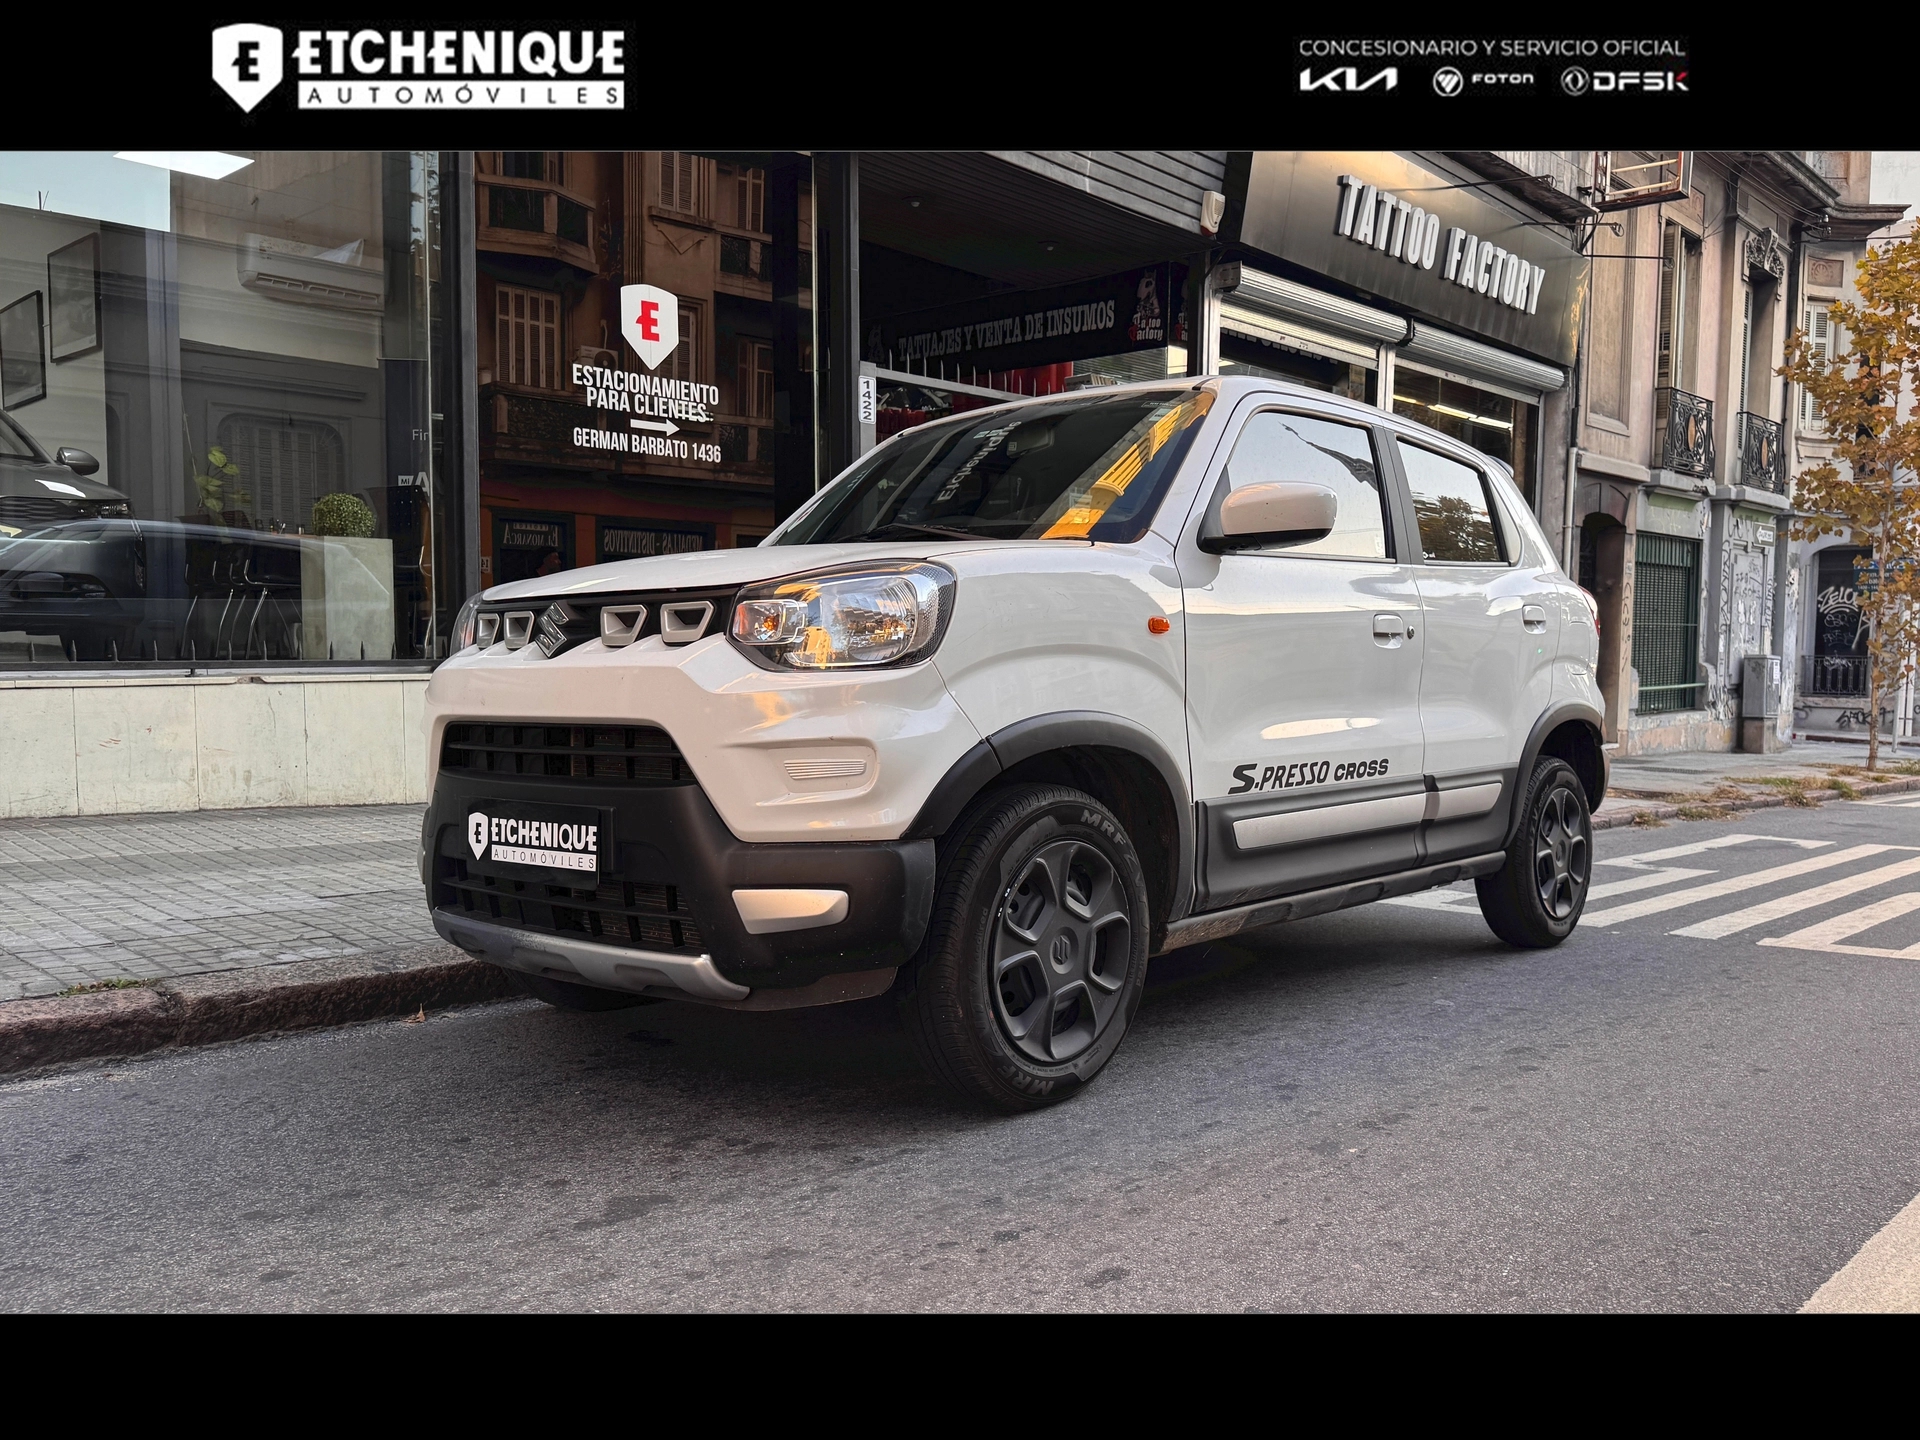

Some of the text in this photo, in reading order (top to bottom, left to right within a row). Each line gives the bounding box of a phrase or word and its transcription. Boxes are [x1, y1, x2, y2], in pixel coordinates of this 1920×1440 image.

[1335, 174, 1546, 316] TATTOO FACTORY
[899, 300, 1115, 362] TATUAJES Y VENTA DE INSUMOS
[572, 363, 719, 406] ESTACIONAMIENTO
[862, 380, 873, 421] 1422
[586, 386, 707, 423] PARA CLIENTES
[573, 427, 722, 463] GERMAN BARBATO 1436
[1334, 758, 1390, 782] CROSS
[491, 817, 598, 852] ETCHENIQUE
[1081, 809, 1126, 847] MRF
[493, 848, 594, 869] AUTOMÓVILES
